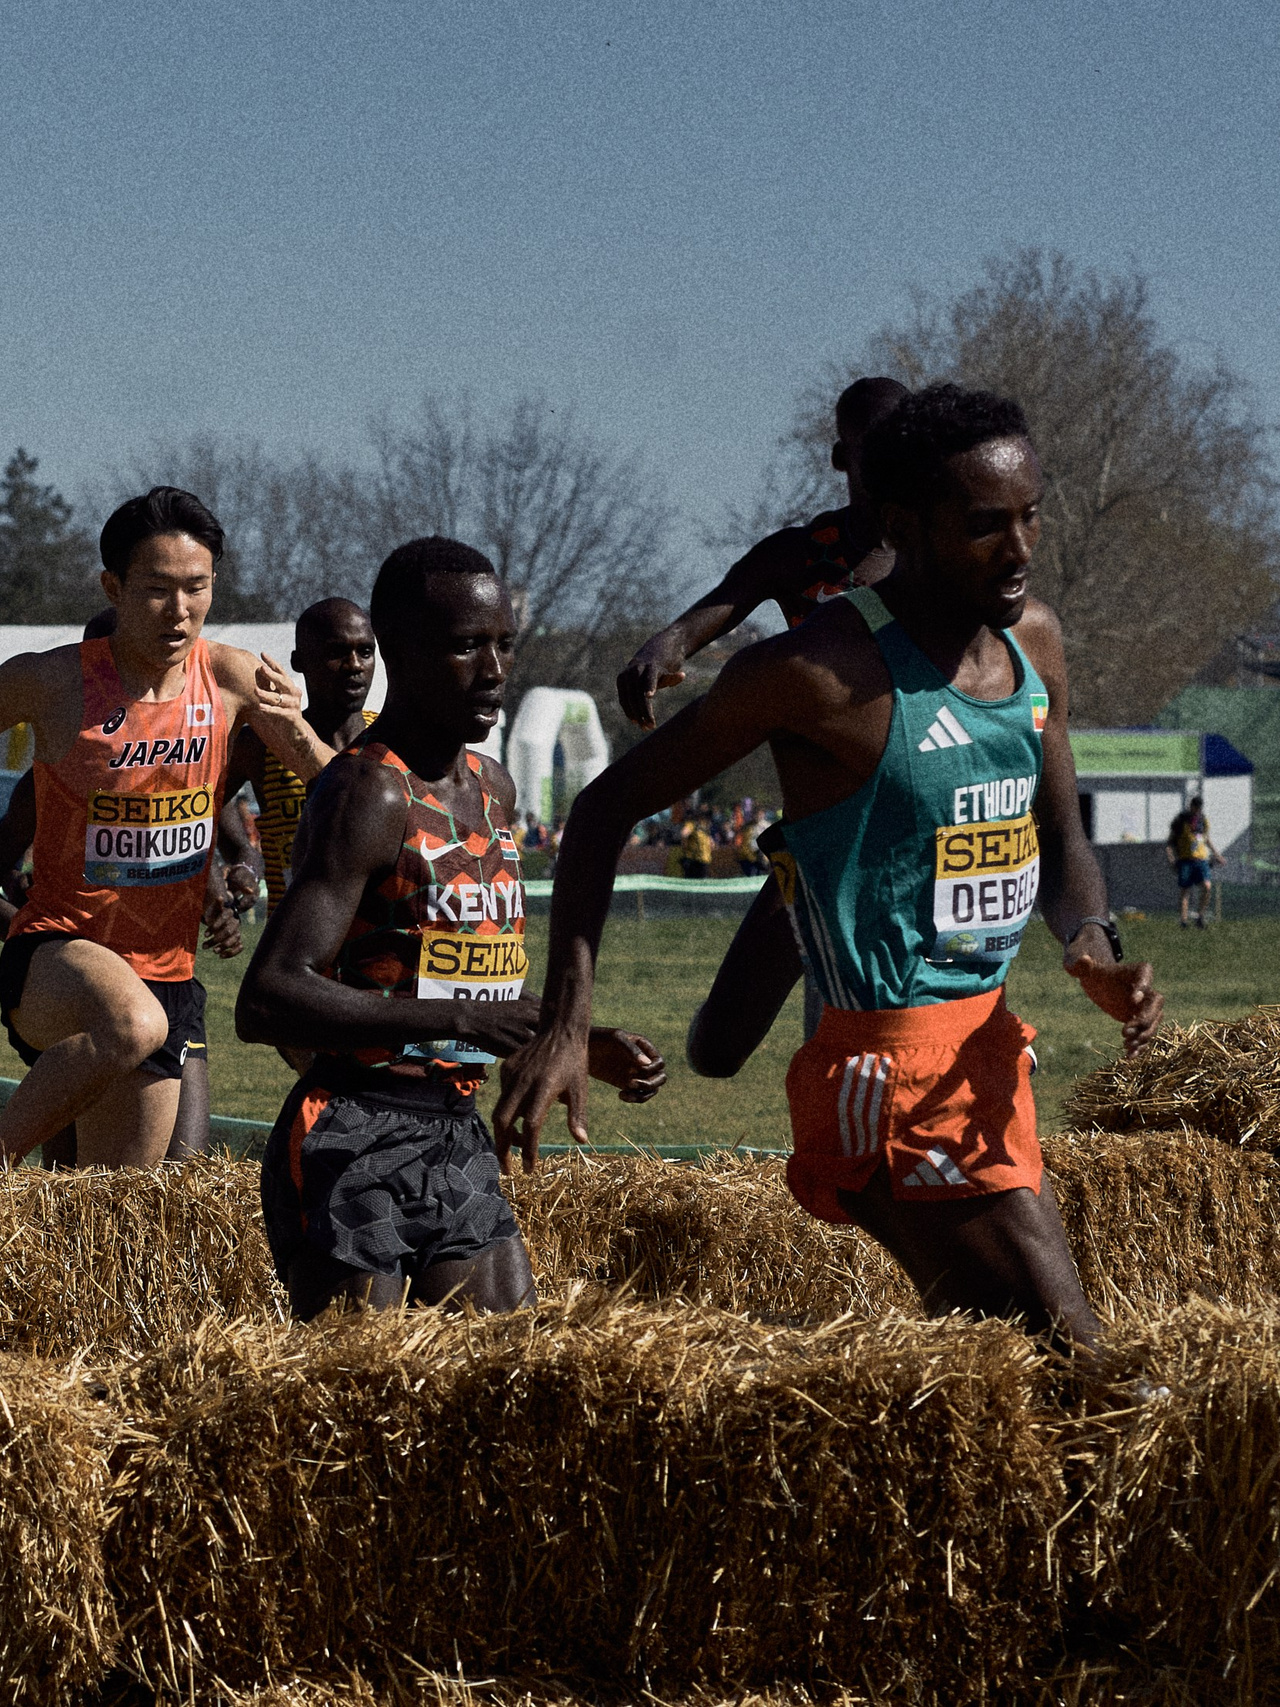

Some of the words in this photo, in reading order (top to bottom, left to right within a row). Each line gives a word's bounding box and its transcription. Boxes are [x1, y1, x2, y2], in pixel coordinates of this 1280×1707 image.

[108, 736, 208, 769] JAPAN
[93, 791, 210, 823] SEIKO
[95, 822, 206, 858] OGIKUBO
[127, 861, 189, 880] BELGRADE
[427, 881, 524, 922] KENYA
[952, 866, 1036, 924] DEBELE
[426, 938, 527, 977] SEIKO
